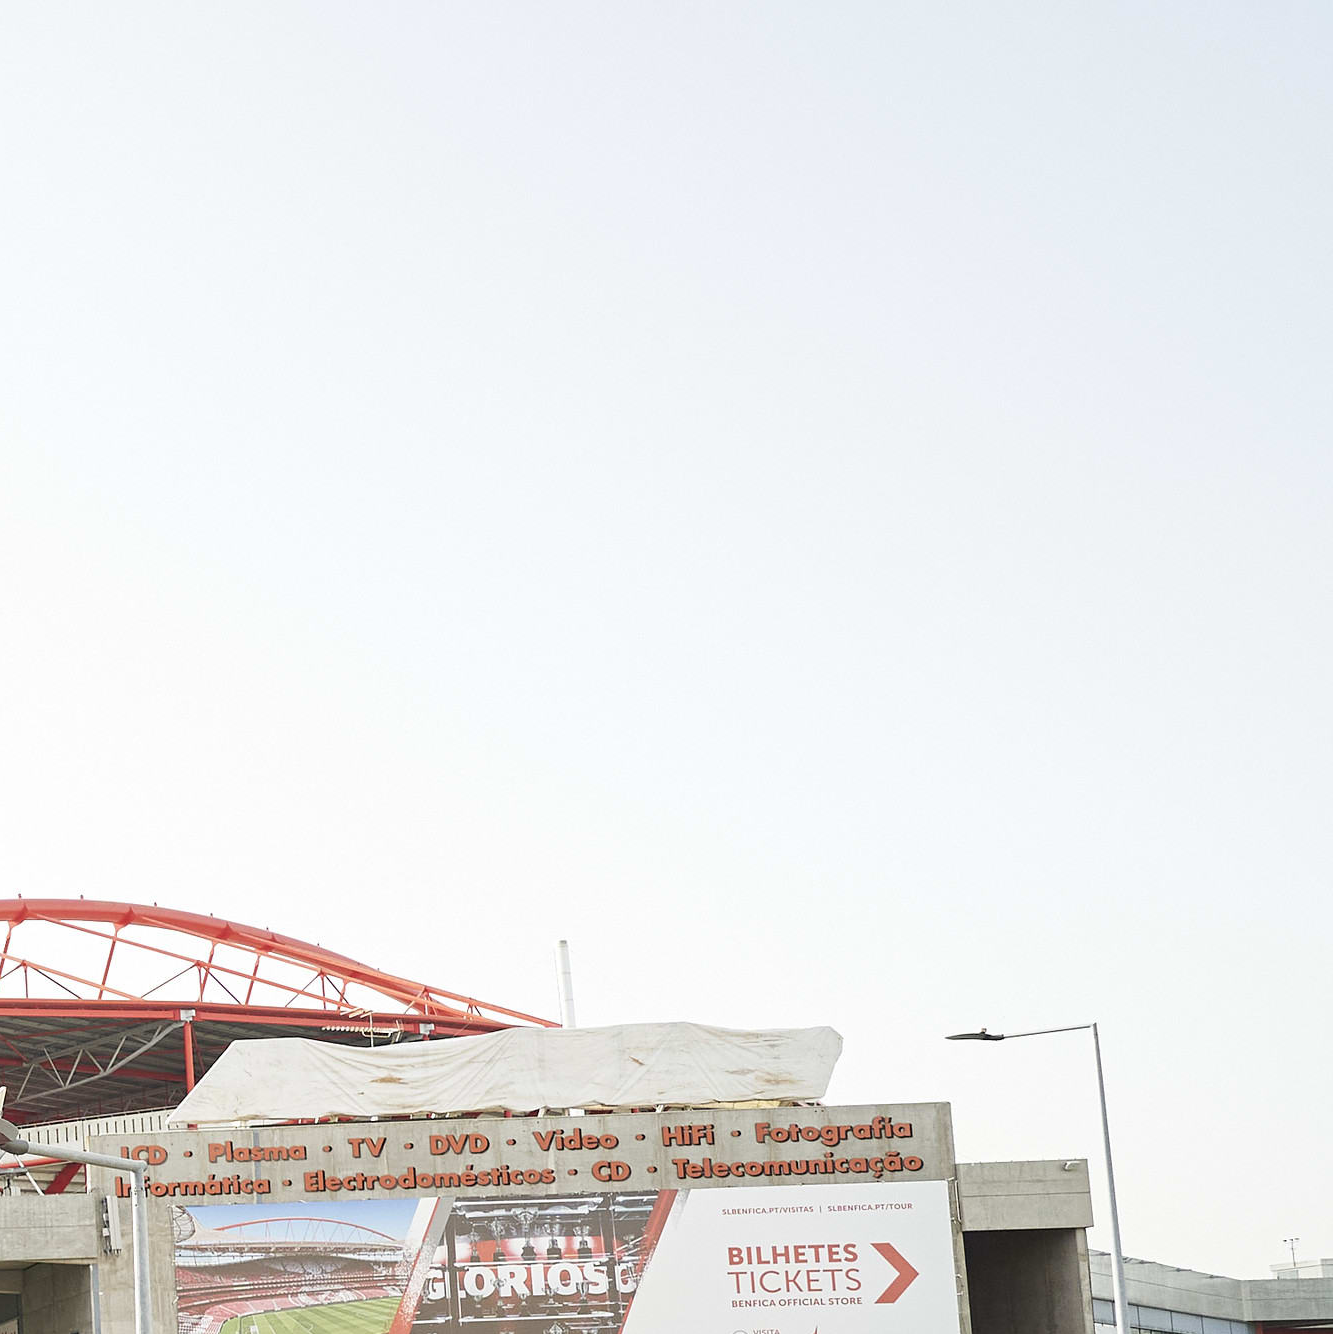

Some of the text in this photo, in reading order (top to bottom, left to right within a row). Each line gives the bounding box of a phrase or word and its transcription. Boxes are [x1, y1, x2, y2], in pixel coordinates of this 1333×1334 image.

[208, 1141, 308, 1163] Plasma
[348, 1137, 388, 1159] TV
[429, 1134, 490, 1156] DVD
[533, 1127, 619, 1152] Video
[661, 1123, 715, 1148] HiFi
[304, 1163, 555, 1193] Electrodomésticos
[591, 1159, 632, 1183] CD
[672, 1150, 924, 1183] Telecomunicação
[722, 1203, 913, 1215] SLBENFICA.PT/VISITAS SLBENFICA.PT/TOUR
[727, 1243, 859, 1266] BILHETES
[727, 1268, 862, 1294] TICKETS
[732, 1297, 863, 1308] BENFICA OFFICIAL STORE
